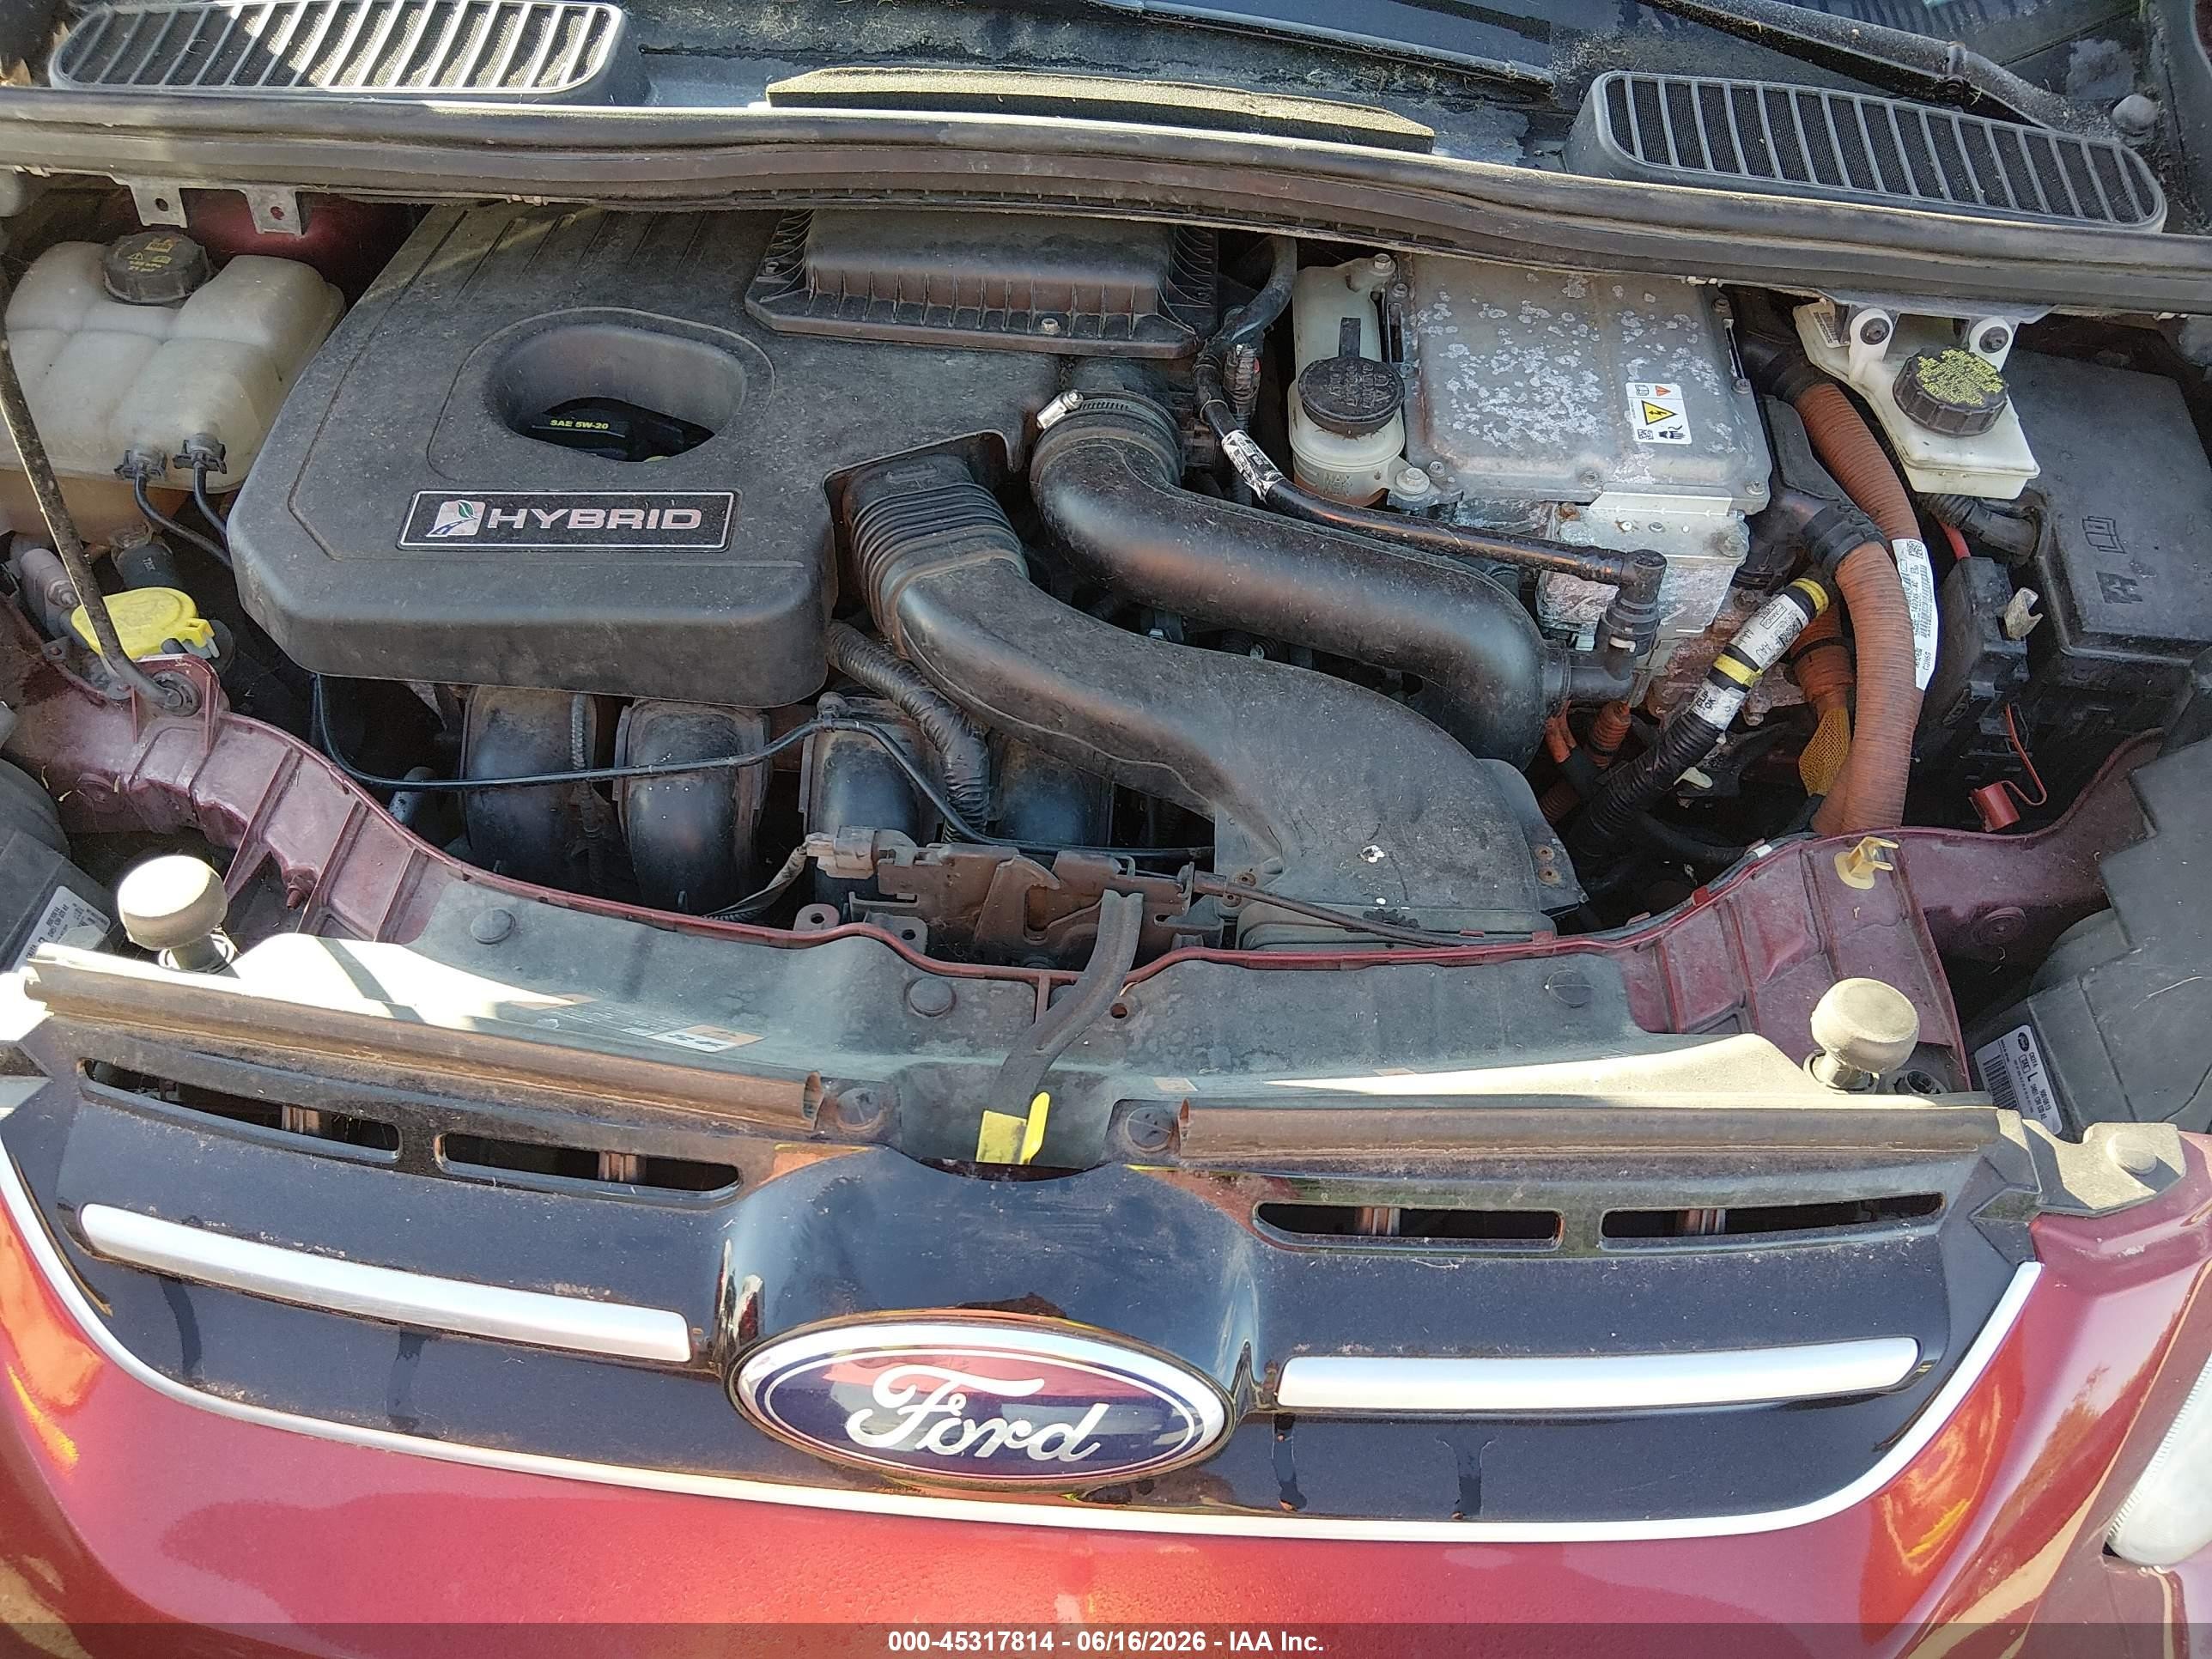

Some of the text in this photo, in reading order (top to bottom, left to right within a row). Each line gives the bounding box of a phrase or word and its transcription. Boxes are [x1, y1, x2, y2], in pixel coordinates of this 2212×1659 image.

[574, 421, 609, 429] 5W-20
[488, 508, 702, 529] HYBRID
[2027, 1072, 2038, 1082] L
[846, 1364, 1109, 1462] Ford
